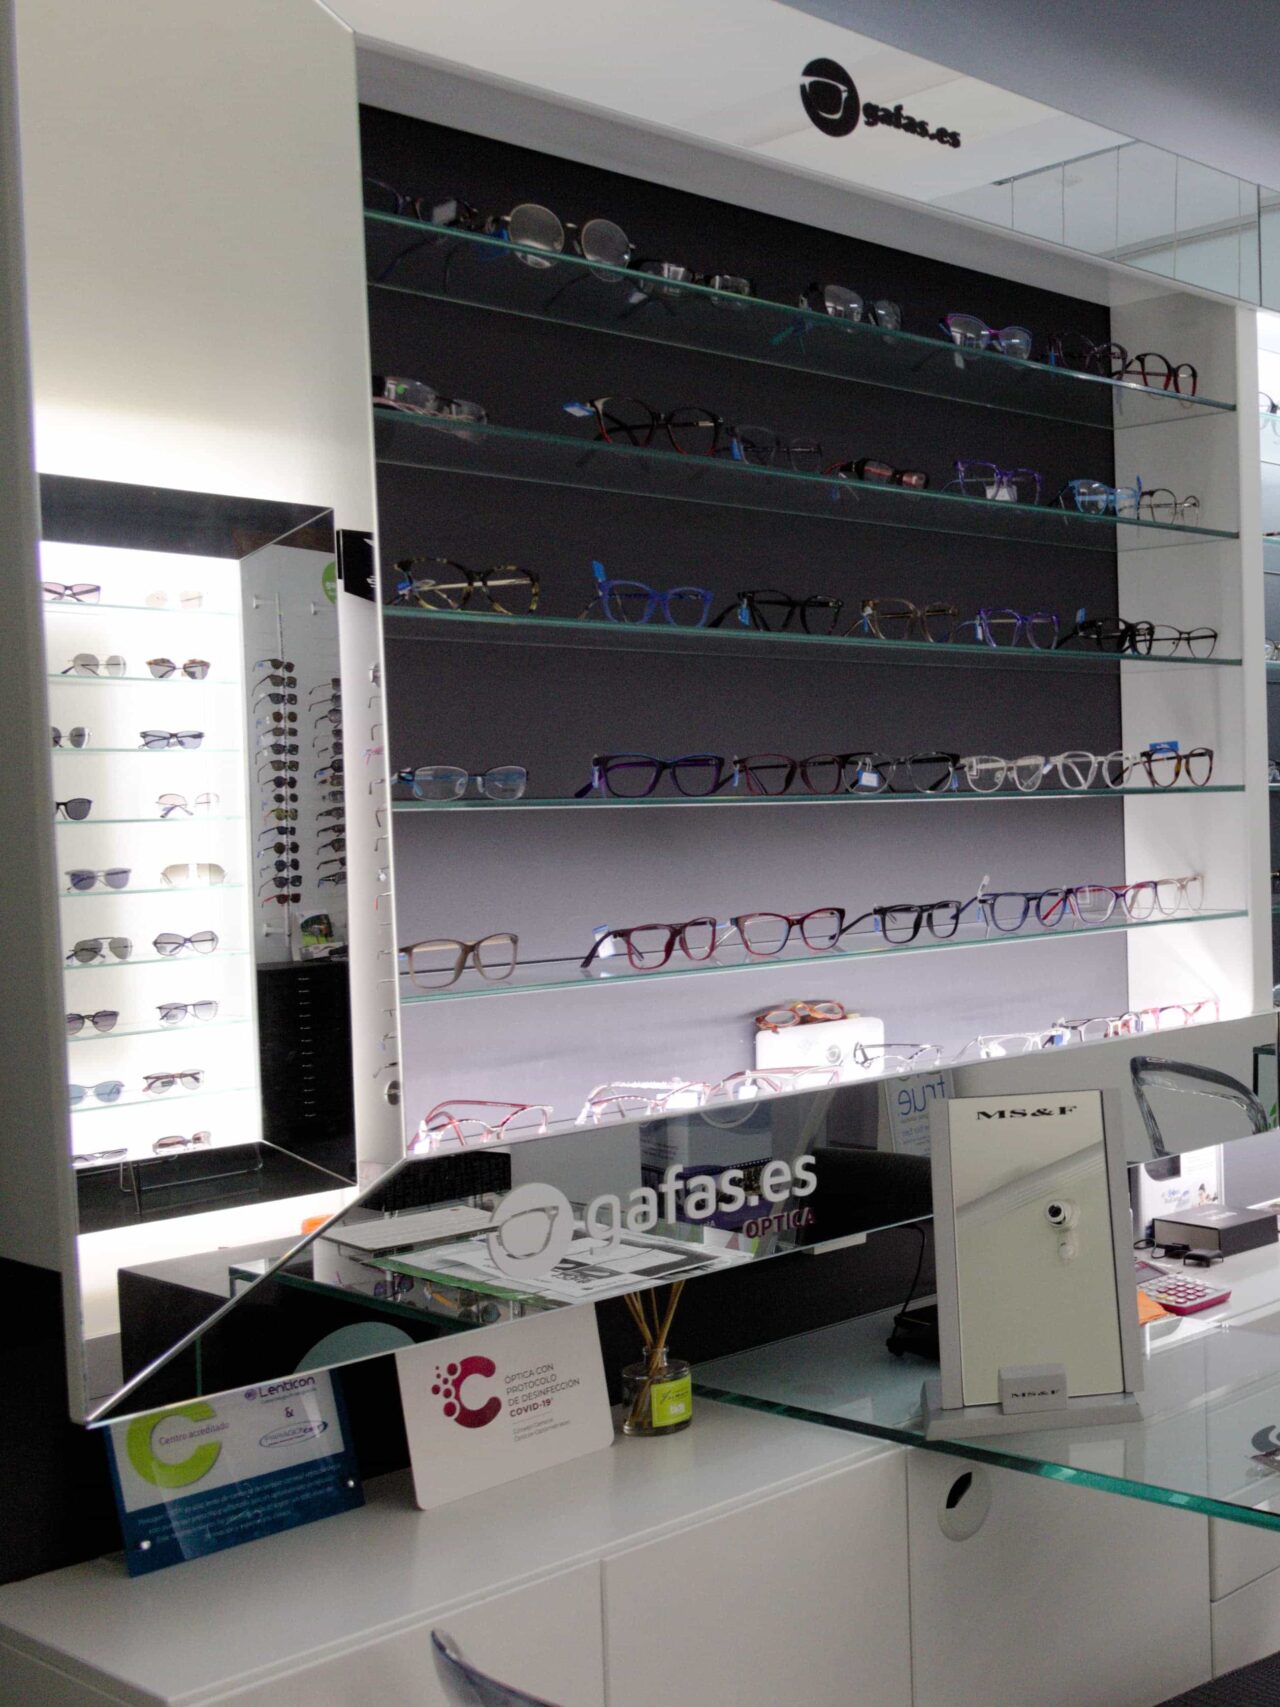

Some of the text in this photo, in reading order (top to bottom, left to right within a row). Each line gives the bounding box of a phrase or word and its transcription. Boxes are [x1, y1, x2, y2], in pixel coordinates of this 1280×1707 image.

[863, 102, 961, 149] gafas.es
[976, 1105, 1078, 1121] MS&F
[586, 1153, 819, 1250] gafas.es
[740, 1206, 817, 1240] OPTICA
[504, 1363, 555, 1385] ÓPTICA CON
[506, 1374, 558, 1396] PROTOCOLO
[258, 1376, 316, 1399] Lenticon
[508, 1377, 581, 1407] DE DESINFECCIÓN
[284, 1407, 294, 1418] &
[158, 1421, 230, 1446] Centro acreditado
